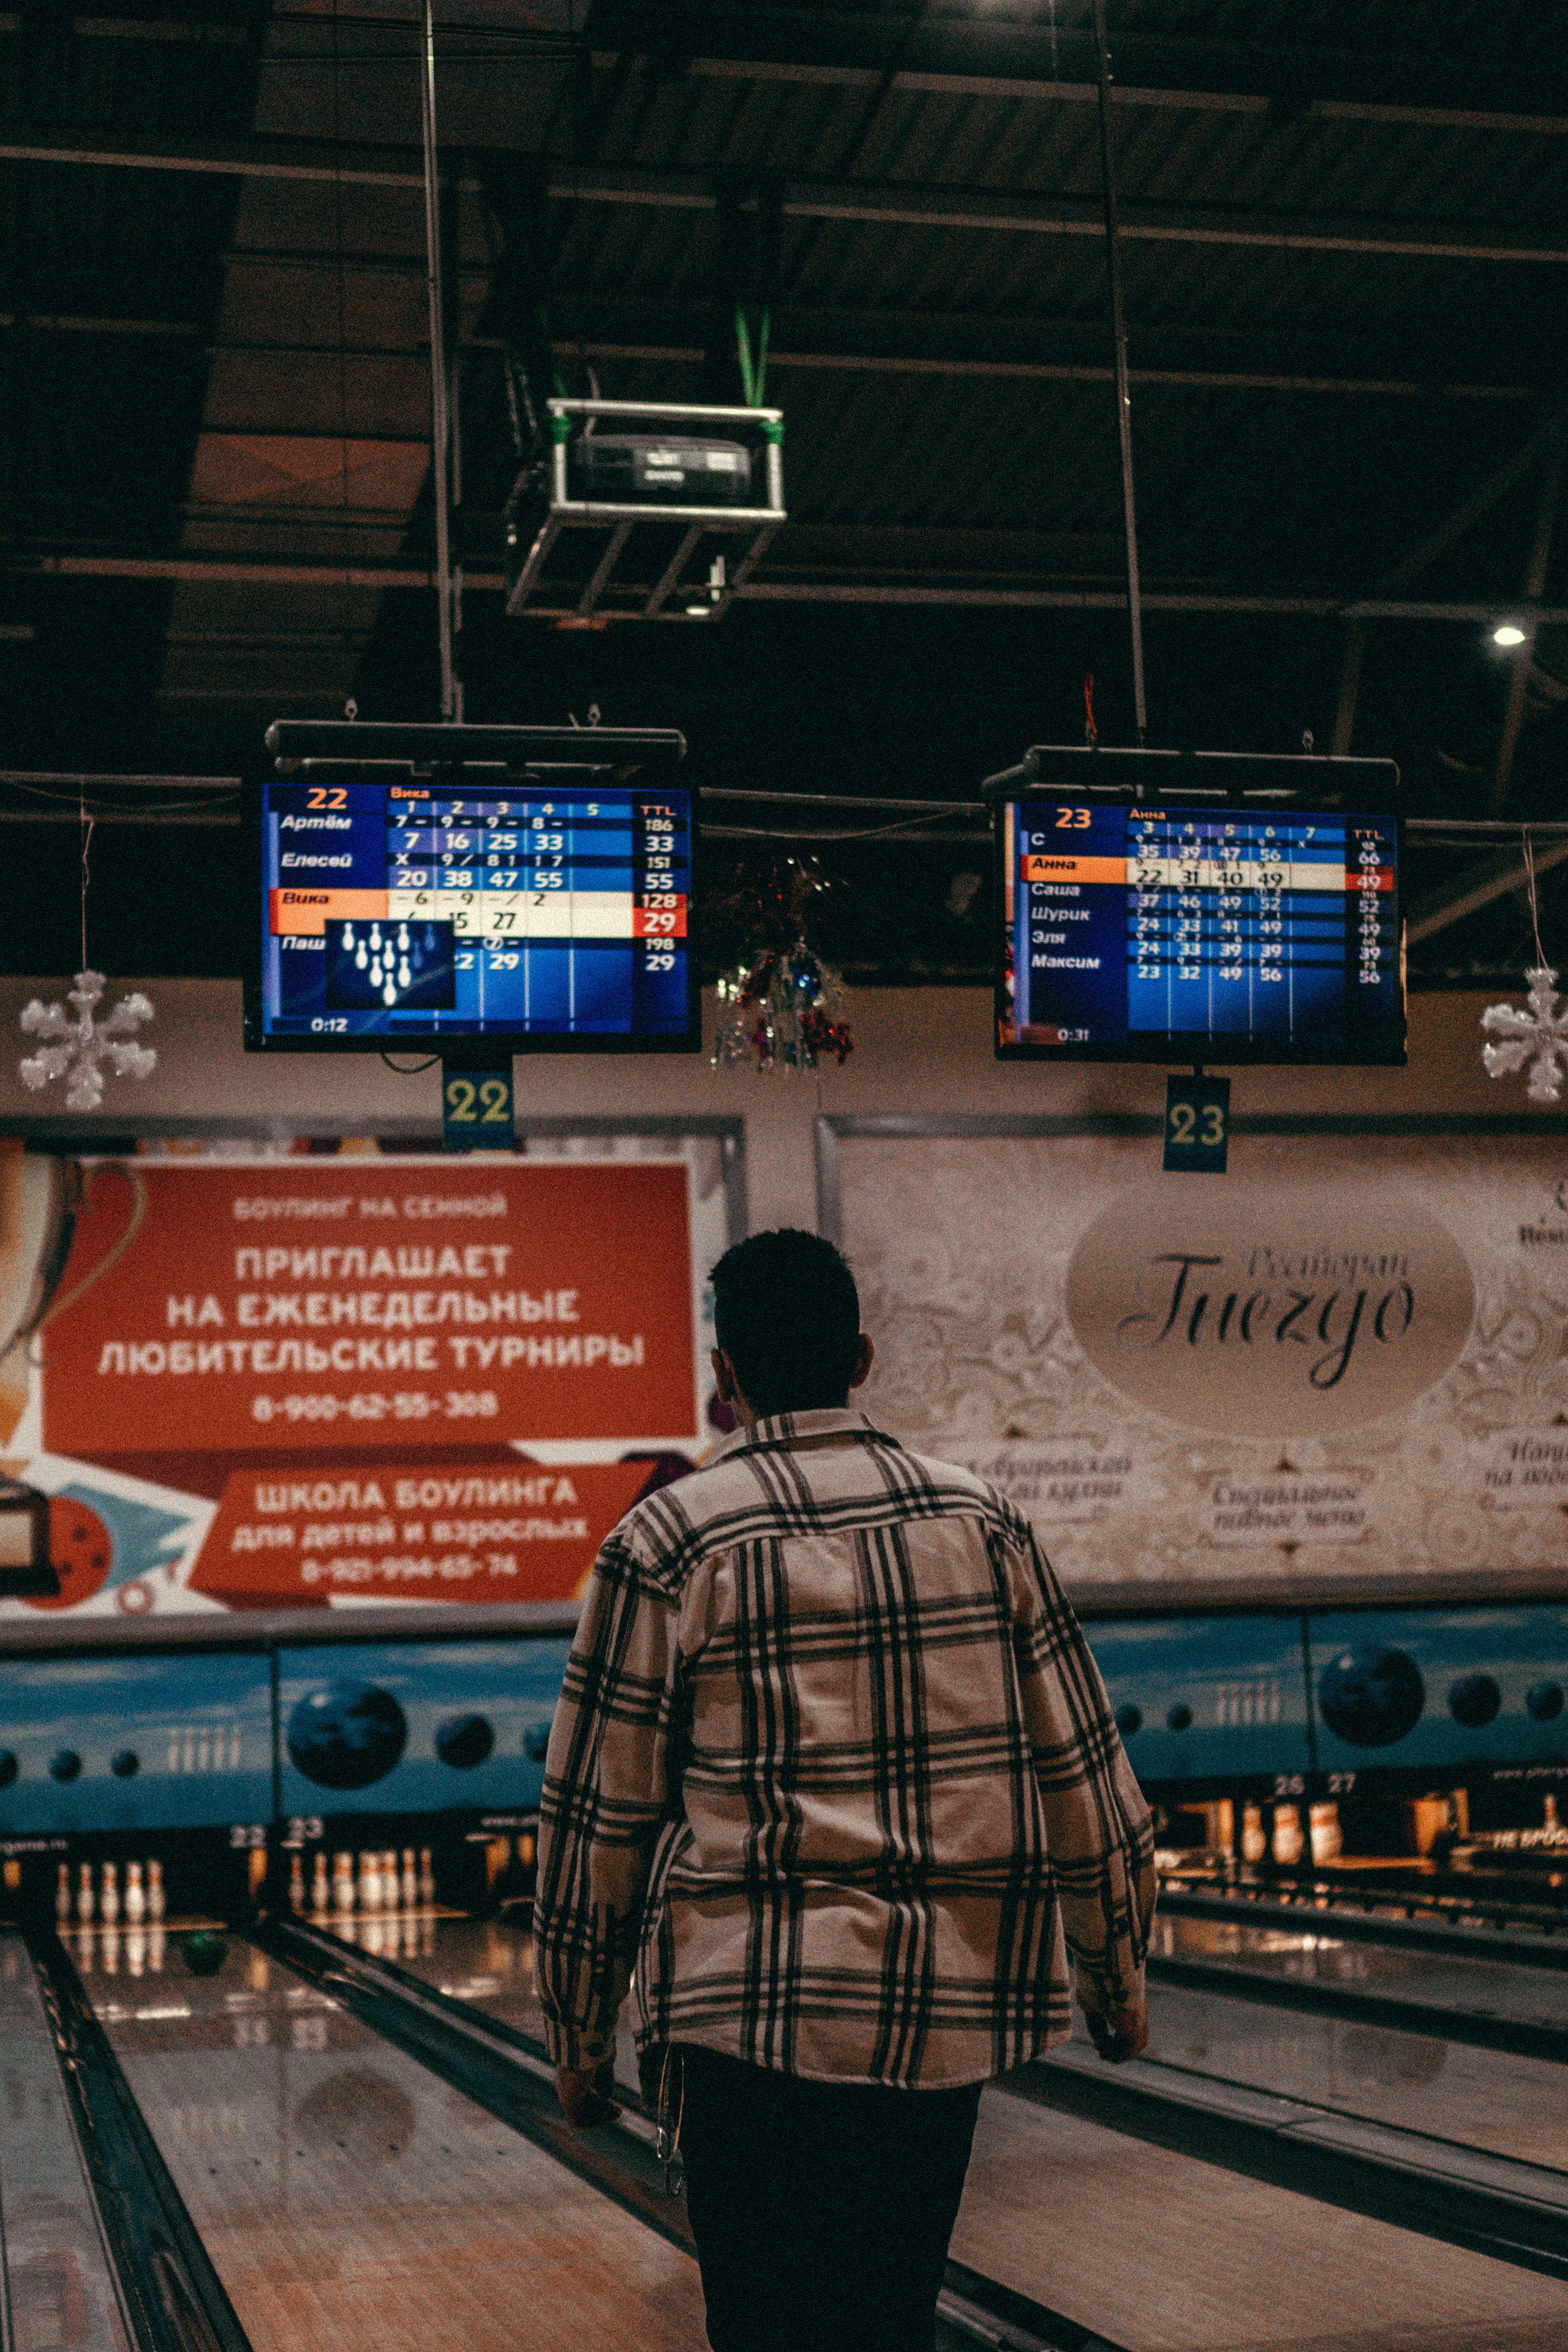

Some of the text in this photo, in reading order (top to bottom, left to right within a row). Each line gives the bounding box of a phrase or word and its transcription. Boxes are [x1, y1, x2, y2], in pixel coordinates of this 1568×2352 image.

[307, 788, 348, 809] 22
[391, 786, 430, 799] Вика
[408, 801, 677, 816] 1 2 3 4 5 TTL
[1055, 808, 1091, 828] 23
[1129, 808, 1166, 820] Анна
[281, 814, 673, 832] Артём 7 9 9 8 186
[1144, 821, 1384, 840] 3 4 5 6 7 TTL
[404, 832, 674, 852] 7 16 25 33 33
[441, 854, 453, 865] 9
[488, 854, 499, 867] 8
[552, 856, 562, 867] 7
[1032, 858, 1076, 870] Анна
[1138, 845, 1381, 865] 35 39 47 56 66
[398, 870, 674, 889] 20 38 47 55 55
[1137, 869, 1382, 889] 22 31 40 49 49
[1031, 883, 1080, 897] Саша
[282, 892, 677, 908] Вика 6 9 2 128
[1139, 895, 1380, 913] 37 46 49 52 52
[492, 912, 516, 929] 27
[644, 913, 676, 932] 29
[1031, 907, 1090, 921] Шурик
[1032, 930, 1066, 944] Эля
[1138, 918, 1381, 937] 24 33 41 49 49
[646, 938, 674, 951] 198
[1138, 941, 1381, 960] 24 33 39 39 39
[490, 953, 519, 970] 29
[646, 955, 675, 971] 29
[1031, 954, 1101, 969] Максим
[1138, 965, 1381, 984] 23 32 49 56 56
[311, 1018, 348, 1032] 0:12
[447, 1079, 510, 1123] 22
[1170, 1102, 1224, 1146] 23
[236, 1245, 512, 1280] ПРИГЛАШАЕТ
[167, 1290, 580, 1330] НА ЕЖЕНЕДЕЛЬНЫЕ
[98, 1335, 644, 1376] ЛЮБИТЕЛЬСКИЕ ТУРНИРЫ
[255, 1477, 578, 1513] ШКОЛА БОУЛИНГА
[402, 1521, 425, 1542] и
[288, 1816, 323, 1841] 23
